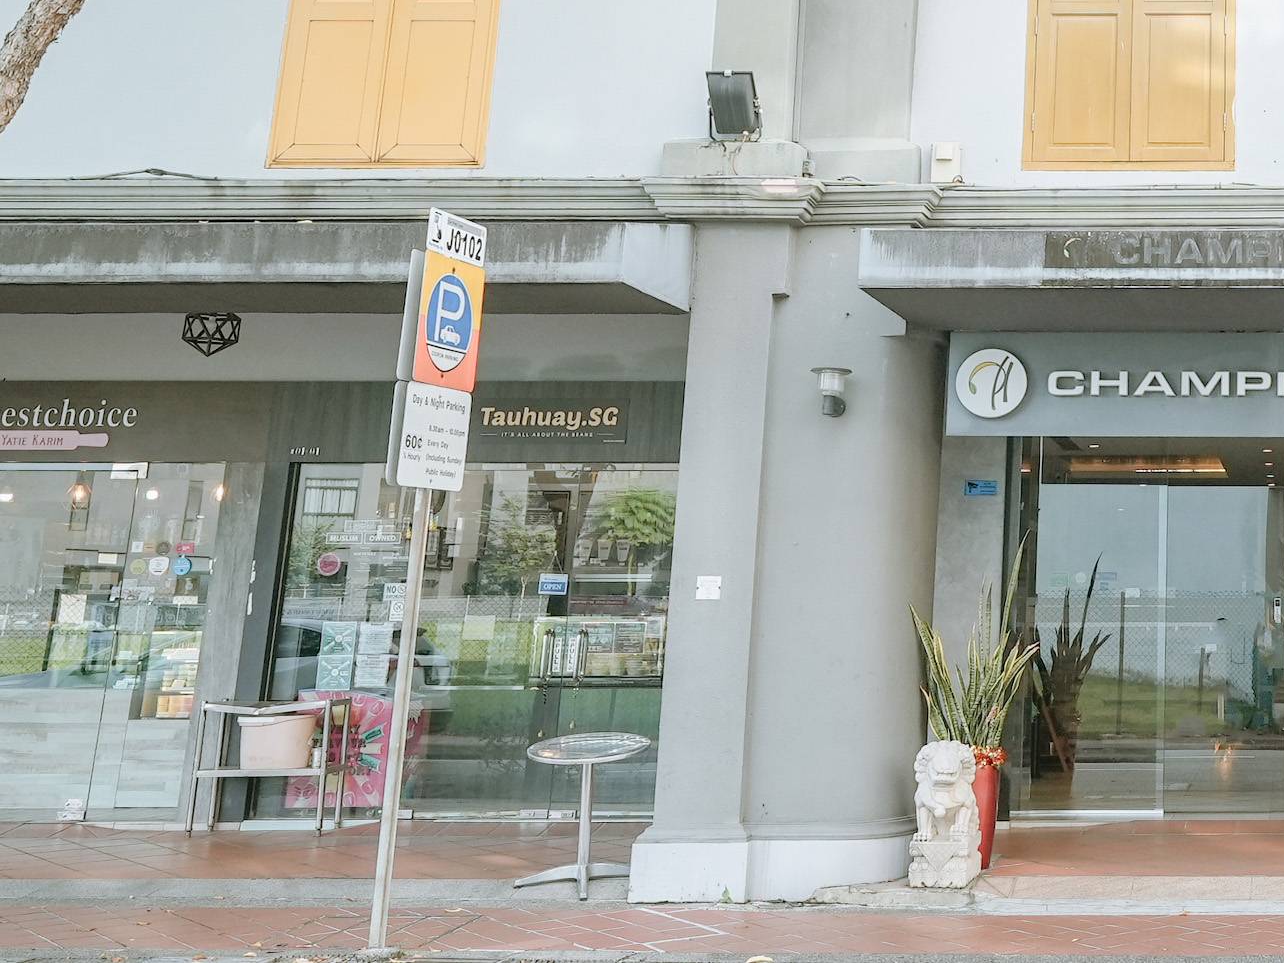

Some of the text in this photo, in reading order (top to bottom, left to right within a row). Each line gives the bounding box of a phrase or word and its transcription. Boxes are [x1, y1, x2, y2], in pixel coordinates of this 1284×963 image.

[447, 228, 482, 261] J0102
[412, 394, 423, 406] Day
[430, 398, 445, 412] Night
[446, 401, 466, 415] Parking
[480, 407, 619, 431] Tauhuay.SG
[1, 434, 64, 446] YATIE KARIM
[329, 534, 359, 542] MUSLIM
[386, 585, 397, 594] NO
[543, 582, 562, 590] OPEN
